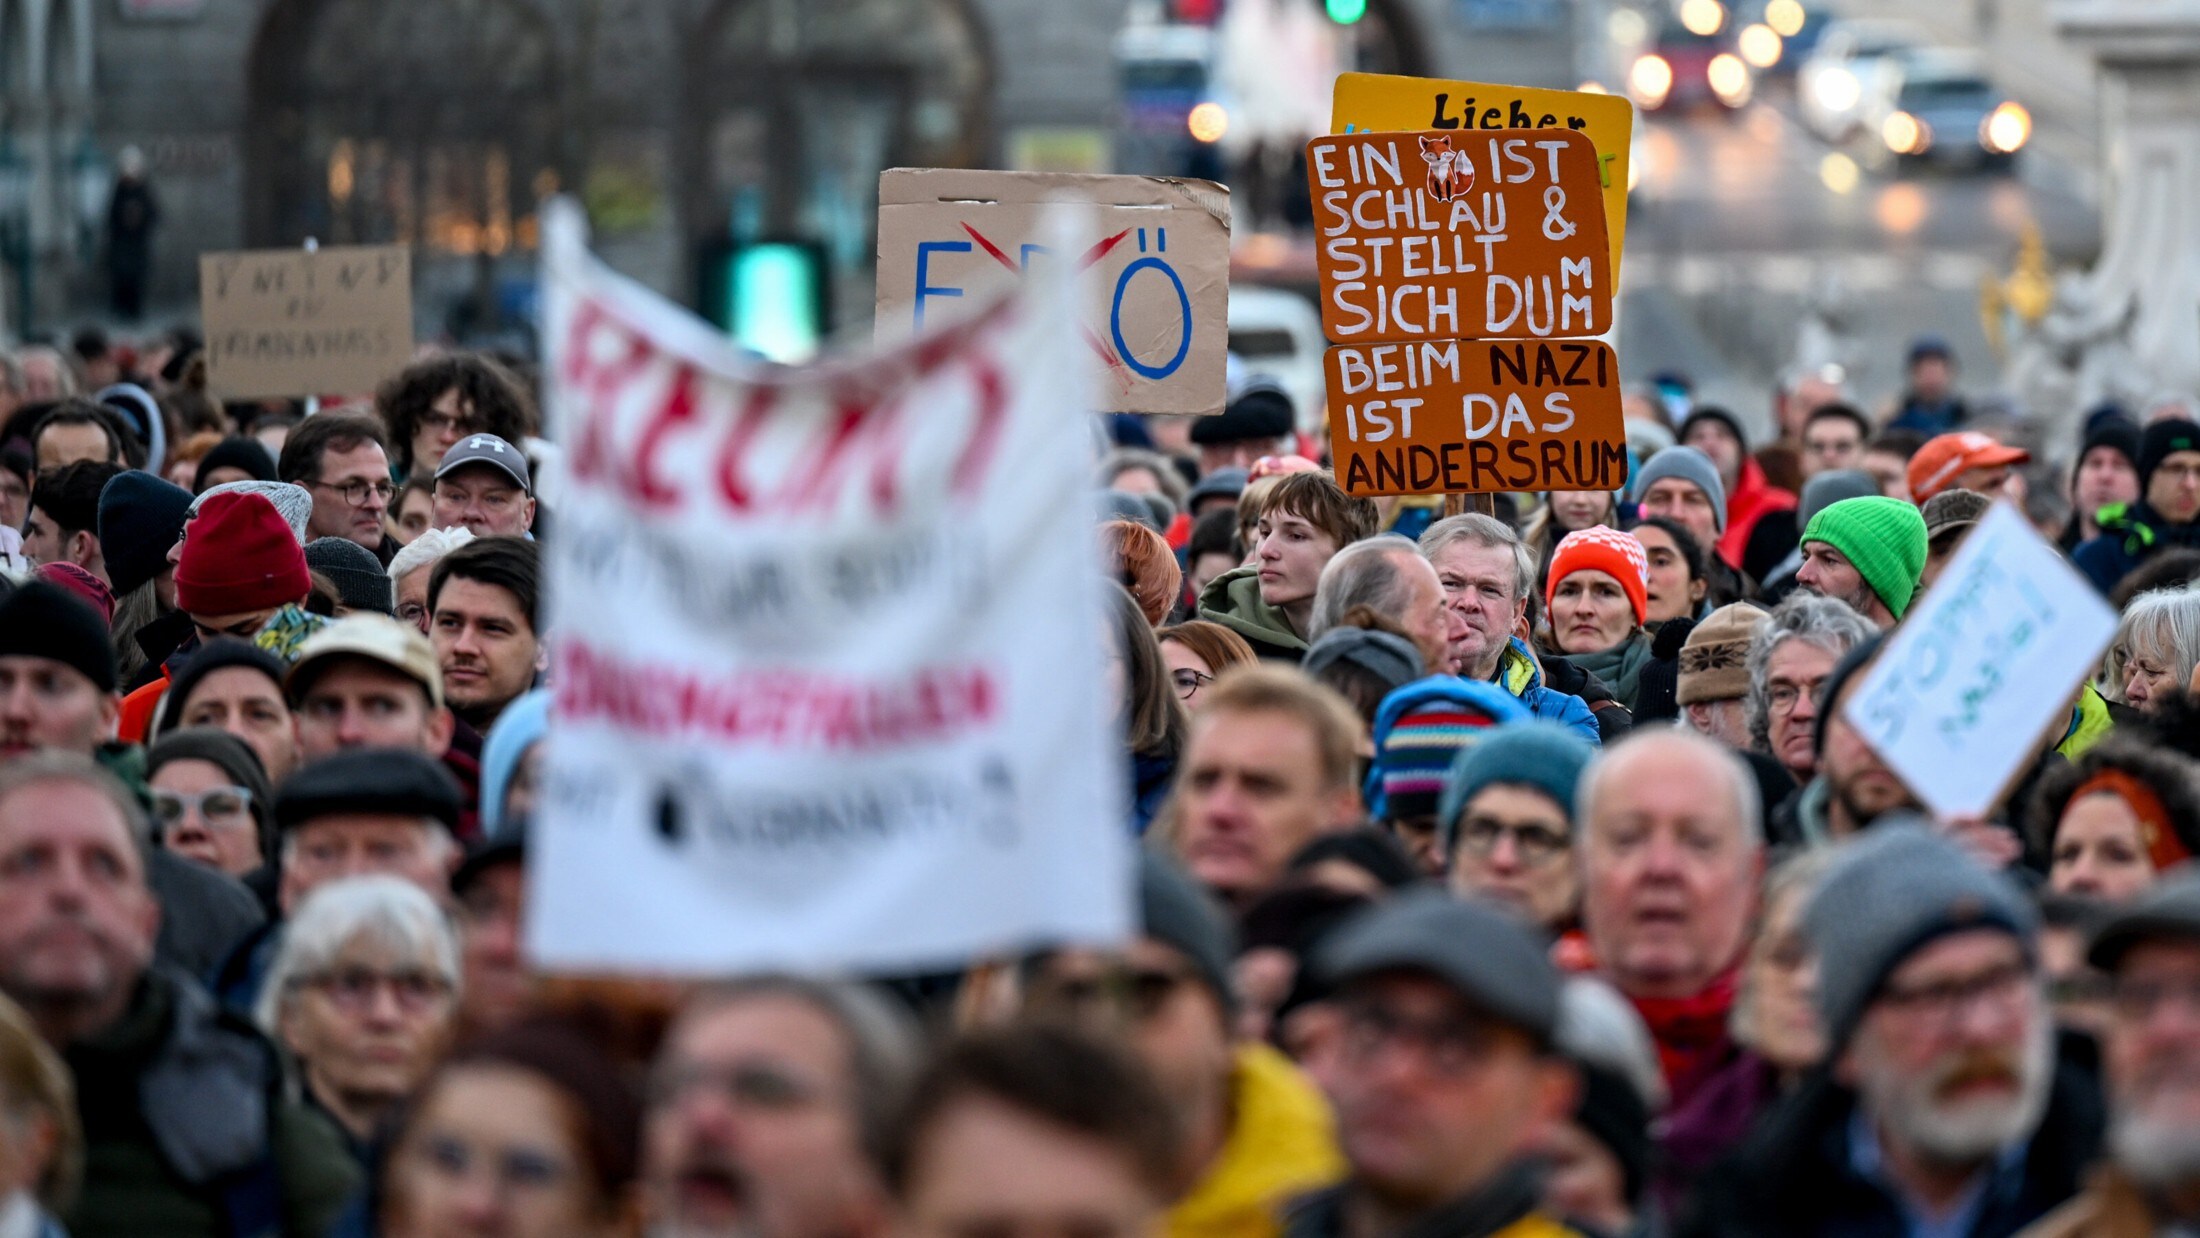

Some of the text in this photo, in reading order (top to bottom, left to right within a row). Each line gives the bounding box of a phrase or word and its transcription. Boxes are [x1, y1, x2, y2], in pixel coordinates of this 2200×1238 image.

[1431, 93, 1586, 129] Lieber
[1313, 142, 1403, 187] EIN
[1489, 138, 1569, 184] IST
[1323, 185, 1577, 241] SCHLAU &
[1327, 233, 1508, 281] STELLT
[1333, 281, 1459, 335] SICH
[1338, 342, 1607, 394] BEIM NAZI
[1346, 391, 1576, 442] IST DAS
[1346, 439, 1628, 492] ANDERSRUM
